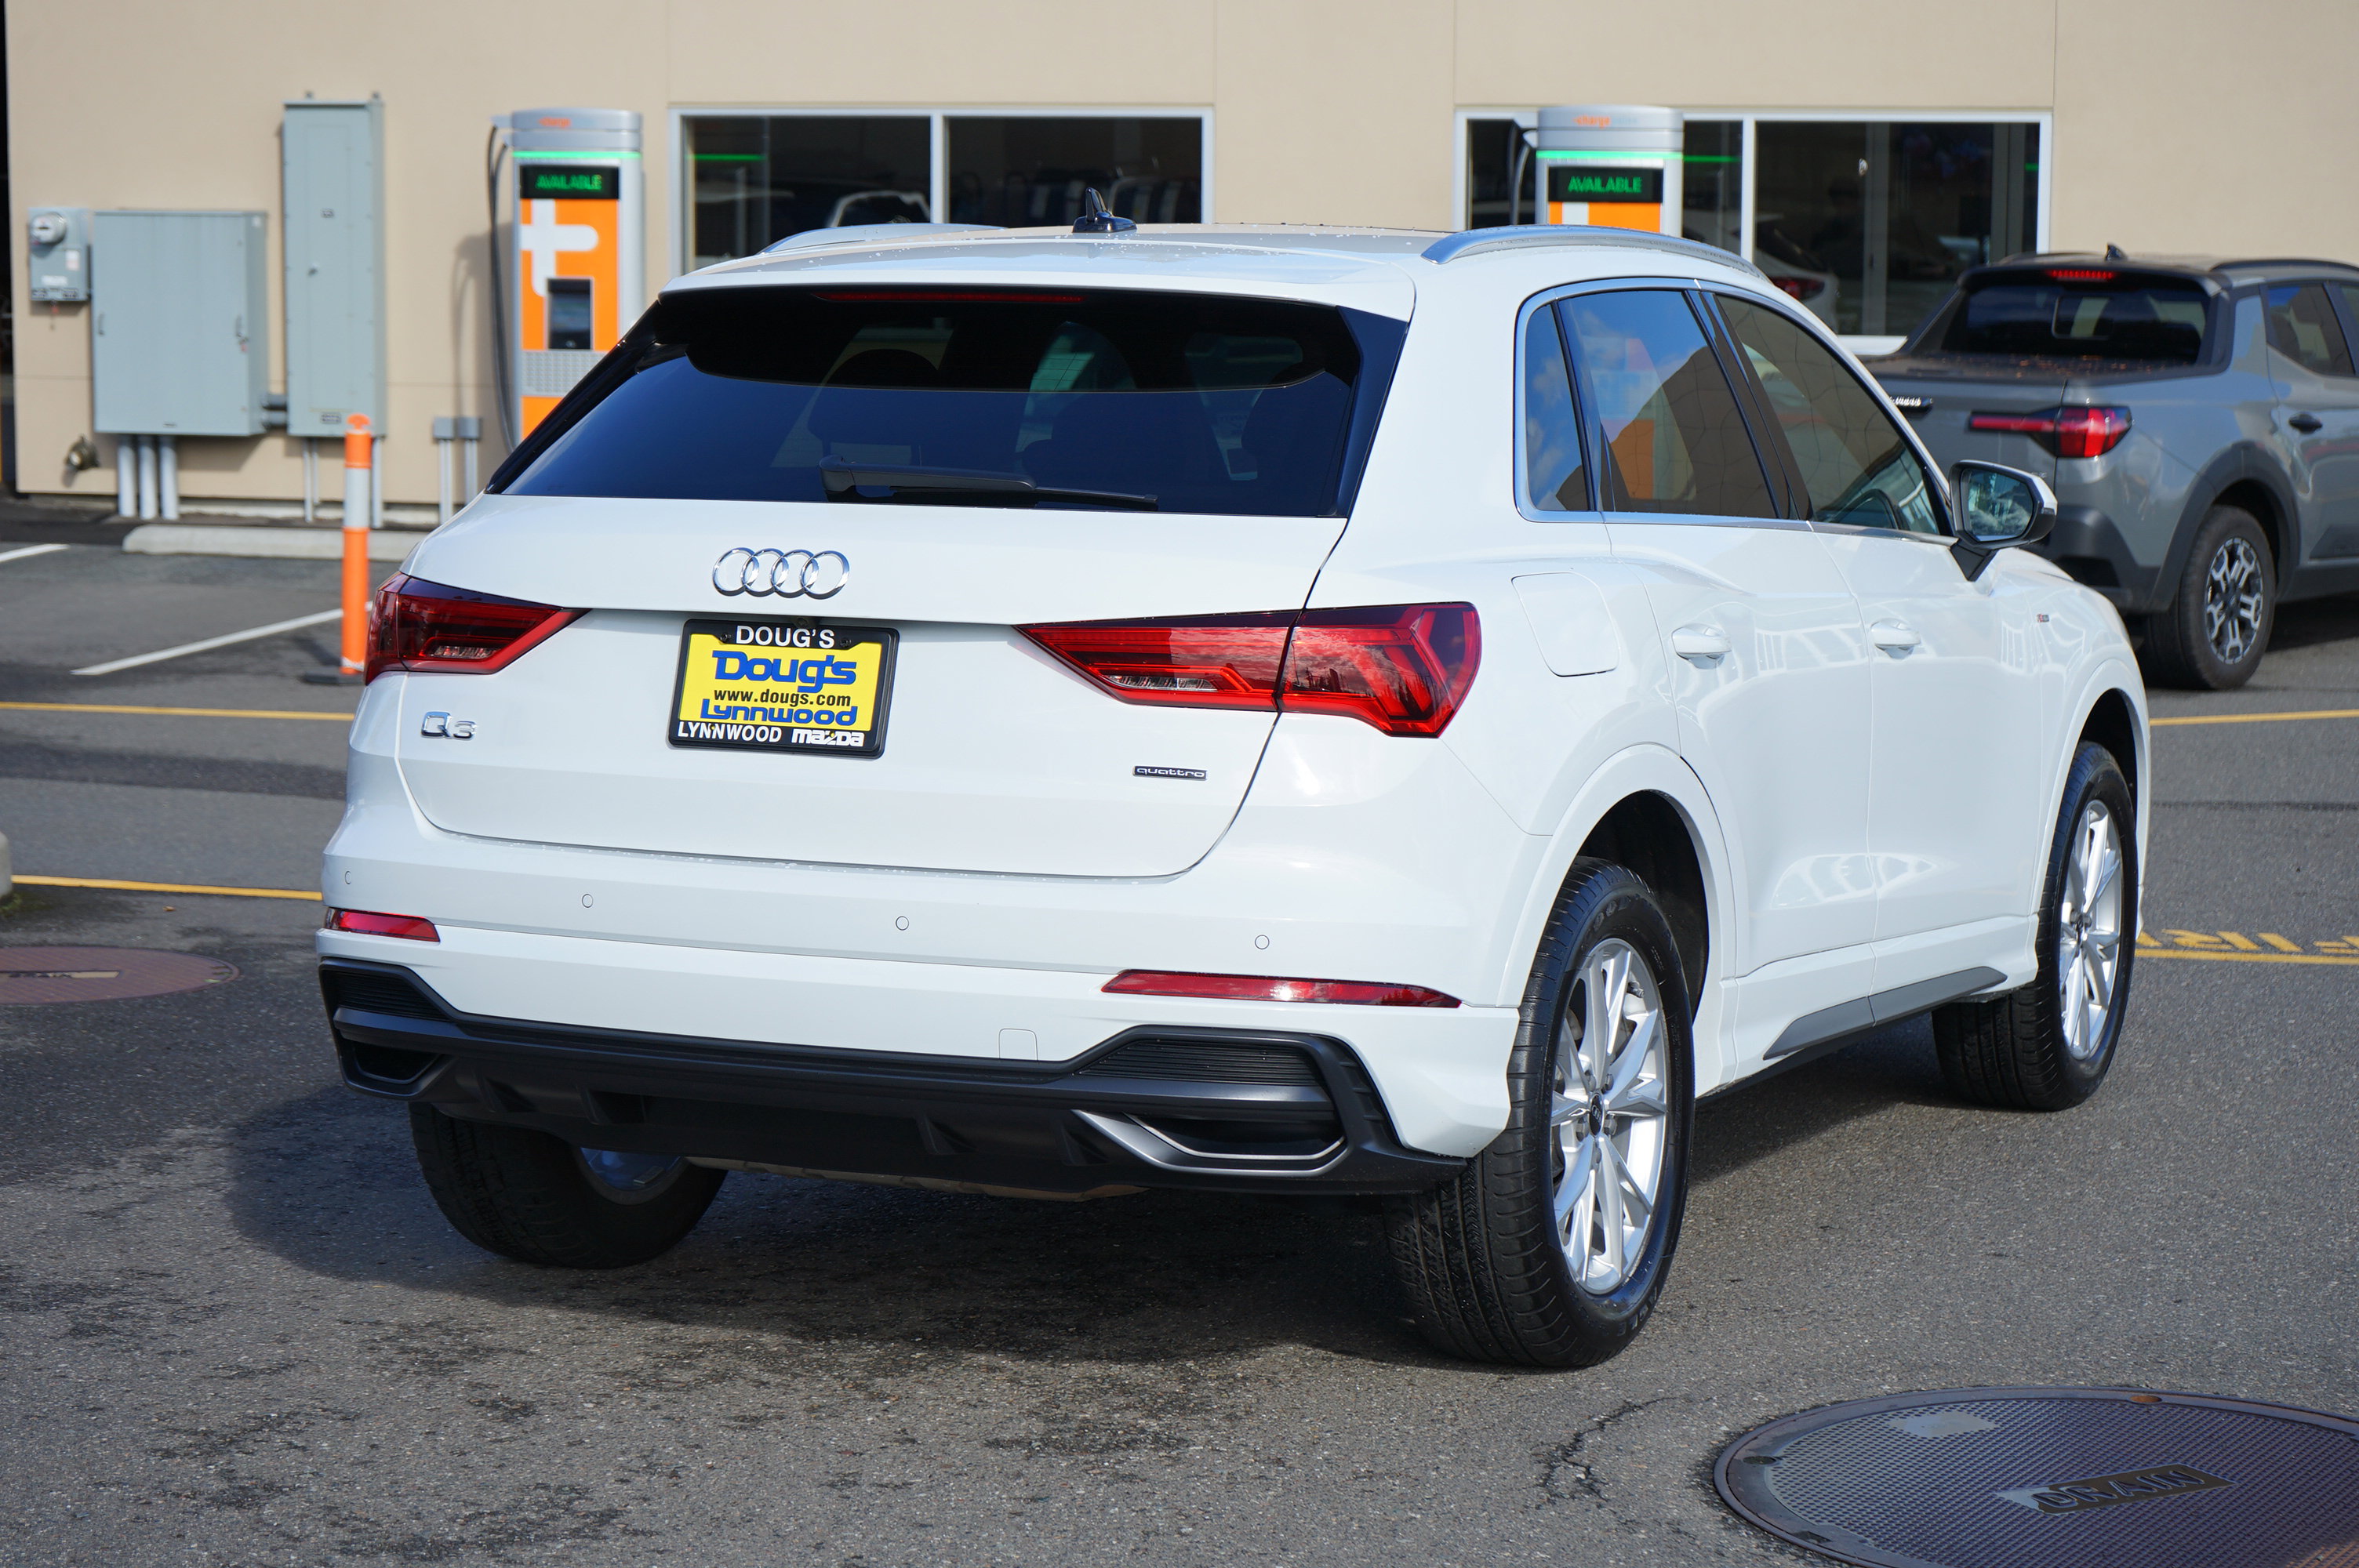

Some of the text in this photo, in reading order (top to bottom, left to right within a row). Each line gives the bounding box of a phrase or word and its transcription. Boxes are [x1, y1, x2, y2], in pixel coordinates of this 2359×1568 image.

[535, 174, 602, 191] AVAILABLE
[1568, 176, 1642, 193] AVAILABLE
[736, 625, 835, 649] DOUG'S
[712, 650, 857, 693] Doug's
[714, 688, 852, 707] www.dougs.com
[700, 699, 859, 726] Lynnwood
[420, 711, 478, 741] Q3
[677, 720, 783, 742] LYNNWOOD
[1136, 768, 1205, 778] quattro
[2030, 1469, 2205, 1508] DRAIN
